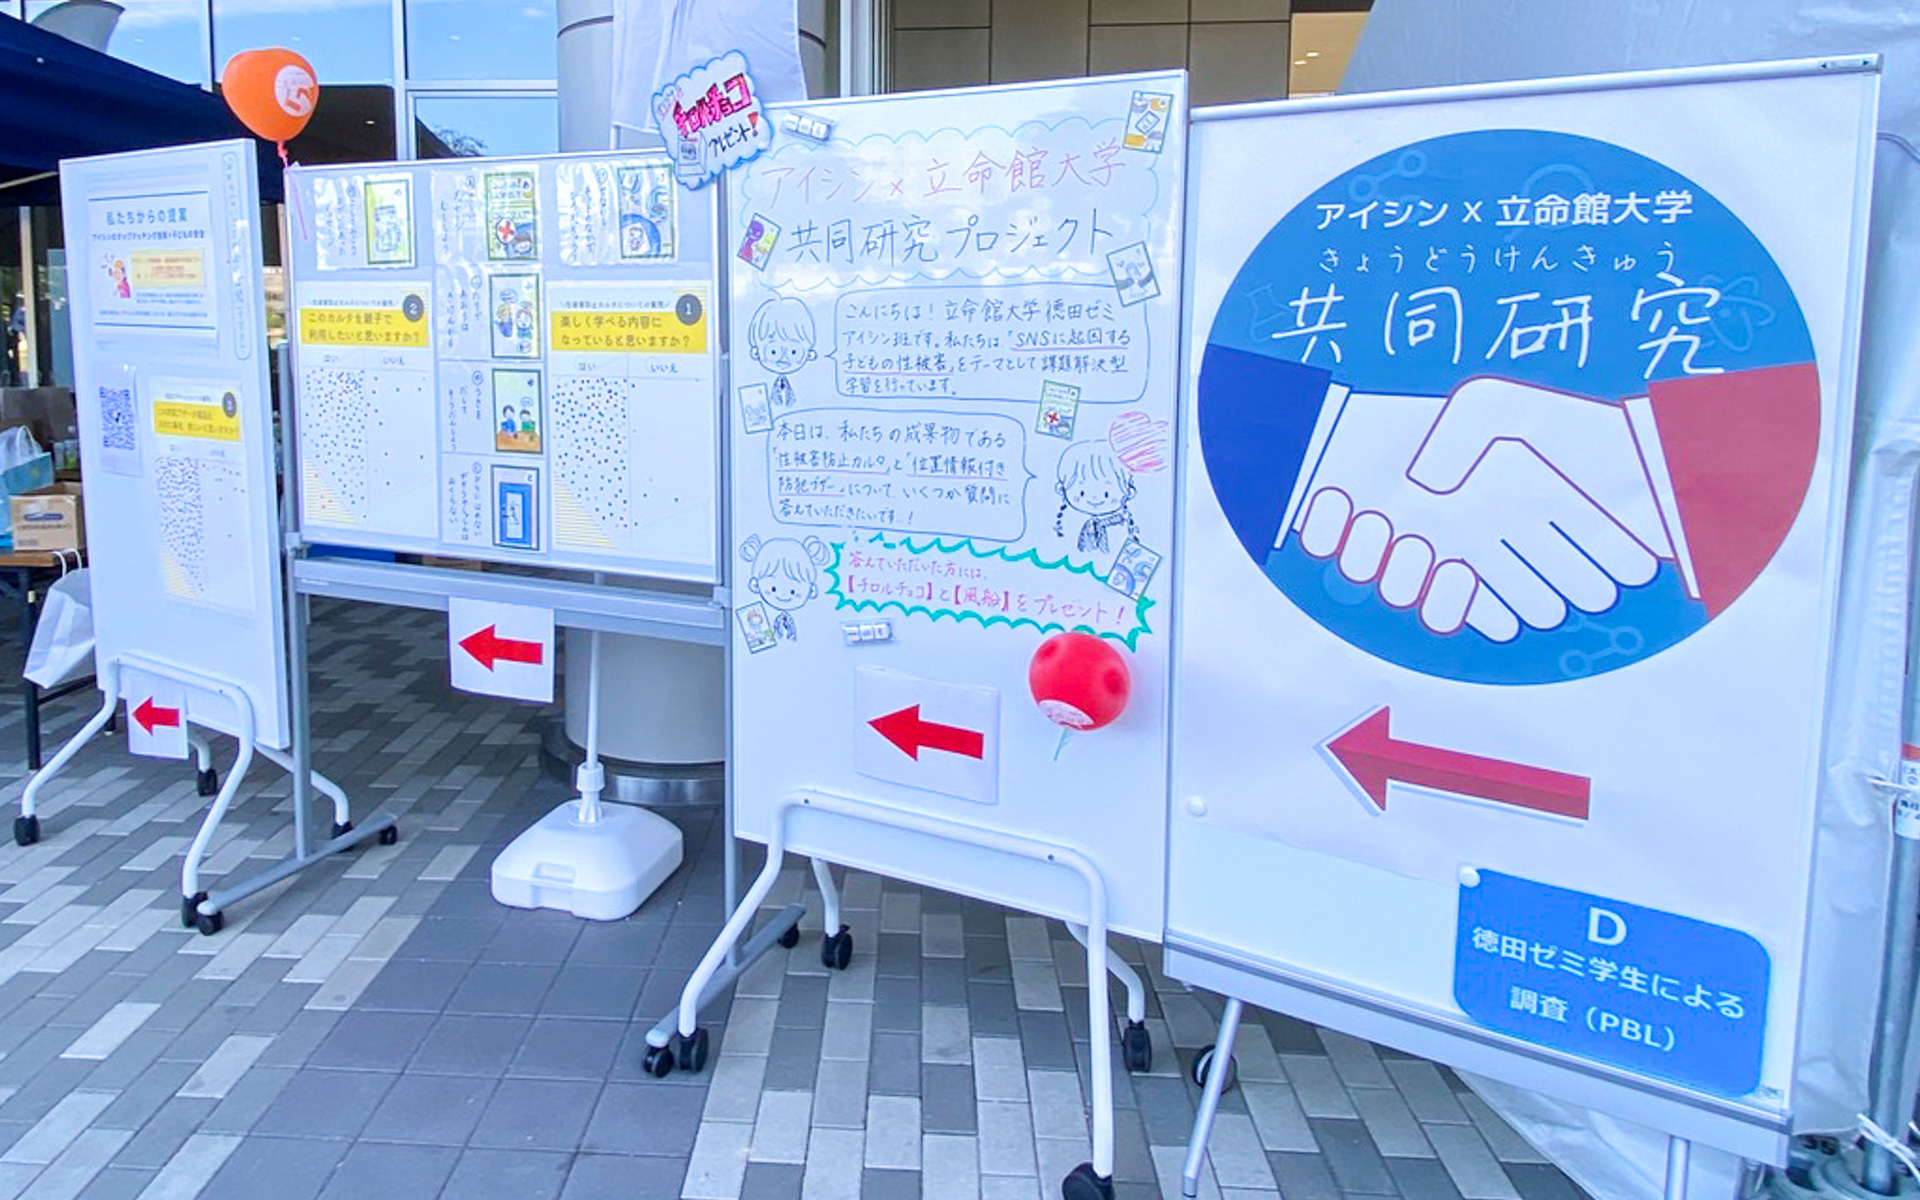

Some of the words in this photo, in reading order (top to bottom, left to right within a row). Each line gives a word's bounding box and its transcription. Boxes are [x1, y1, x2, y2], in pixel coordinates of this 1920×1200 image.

[761, 165, 875, 209] アイシン
[923, 137, 1126, 197] 立命館大学
[1316, 199, 1449, 230] アイシン
[1495, 190, 1694, 226] 立命館大学
[409, 303, 418, 315] 2
[560, 315, 663, 329] 楽しく学べる内容に
[1272, 273, 1725, 379] 共同研究
[561, 334, 691, 348] なっていると思いますか？
[650, 362, 678, 373] いいえ
[1587, 906, 1628, 946] D
[1471, 926, 1745, 1020] 徳田ゼミ学生による
